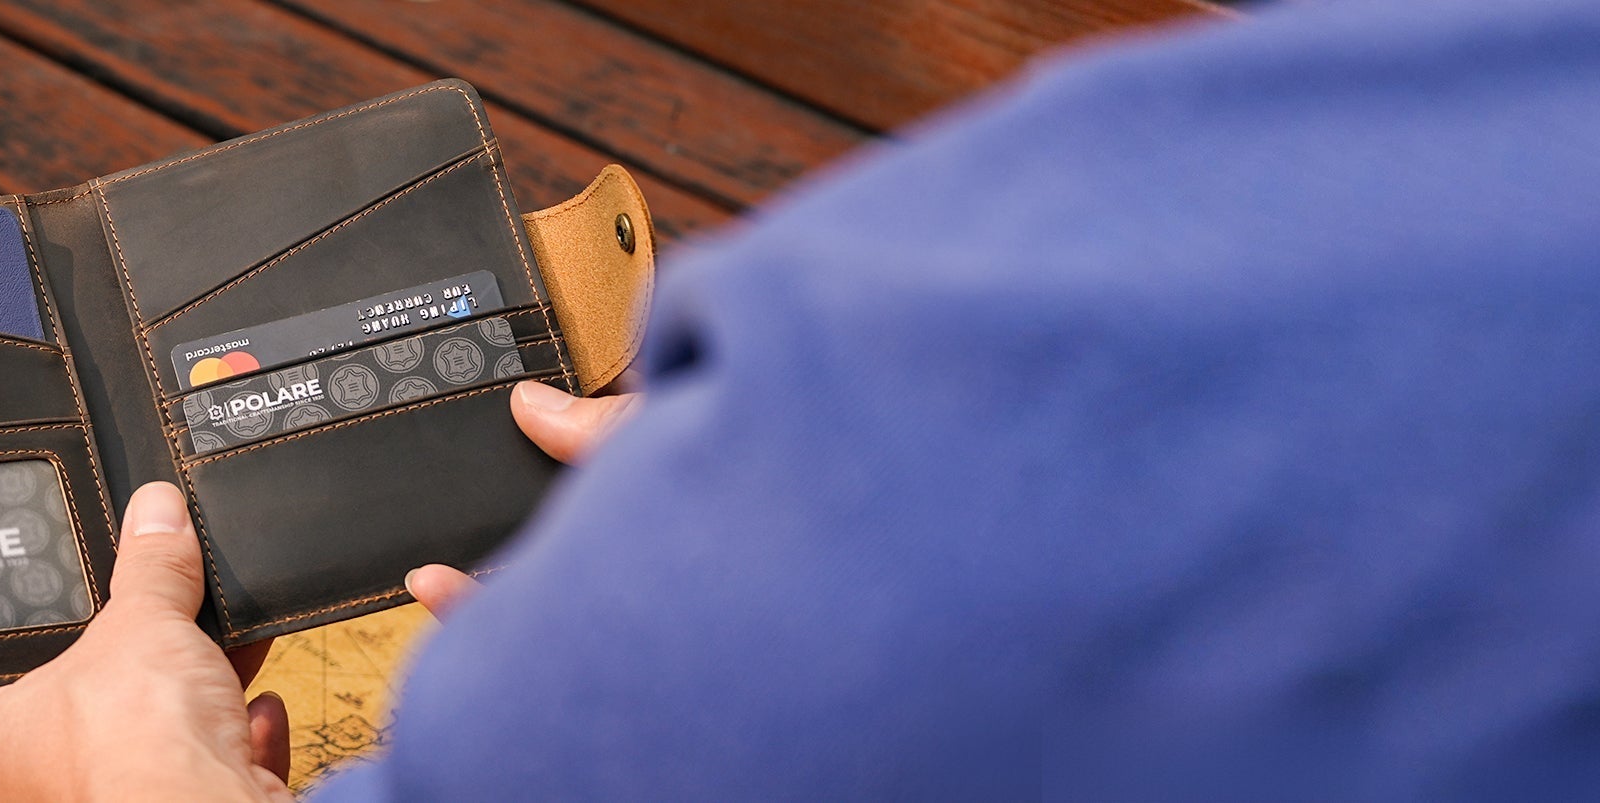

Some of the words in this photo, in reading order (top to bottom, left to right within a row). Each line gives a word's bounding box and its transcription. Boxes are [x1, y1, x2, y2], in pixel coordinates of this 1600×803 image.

[441, 284, 472, 300] EUR
[357, 293, 433, 320] CURRENCY
[420, 297, 478, 320] LIPING
[361, 313, 411, 334] HUANG
[186, 338, 249, 361] mastercard
[230, 379, 322, 416] POLARE
